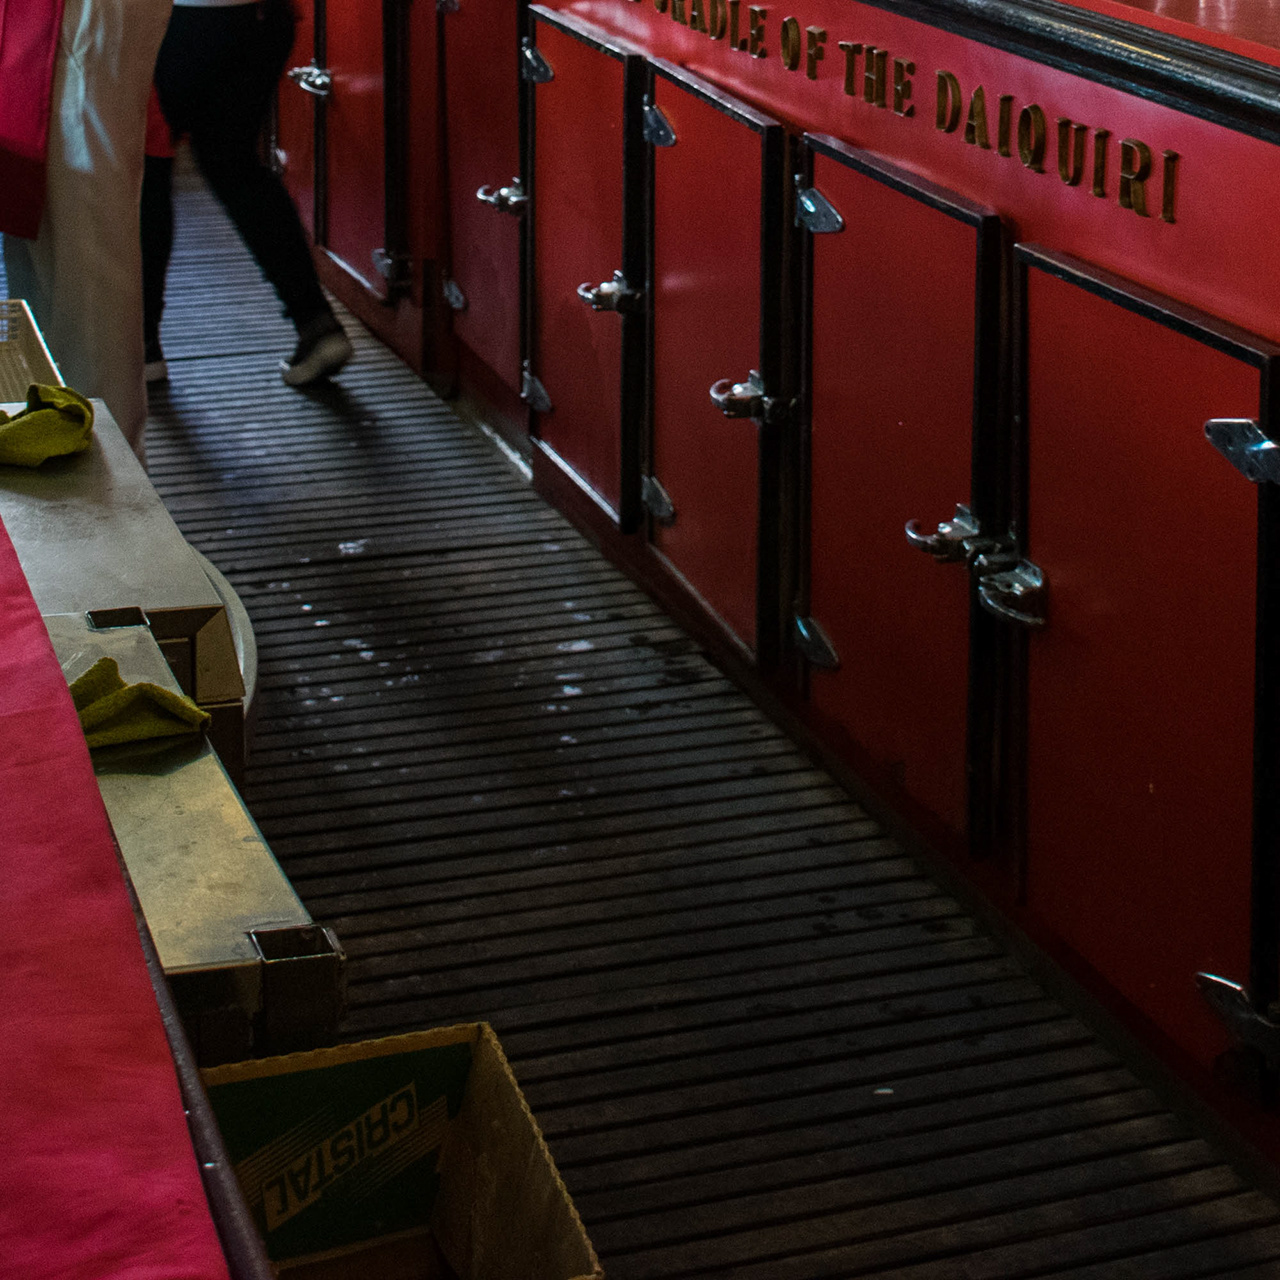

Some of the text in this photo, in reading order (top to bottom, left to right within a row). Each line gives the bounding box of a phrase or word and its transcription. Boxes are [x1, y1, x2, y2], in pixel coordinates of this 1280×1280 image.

[781, 15, 827, 81] OF
[838, 40, 916, 118] THE
[934, 69, 1180, 224] DAIQUIRI
[265, 1088, 416, 1216] CRISTAL
